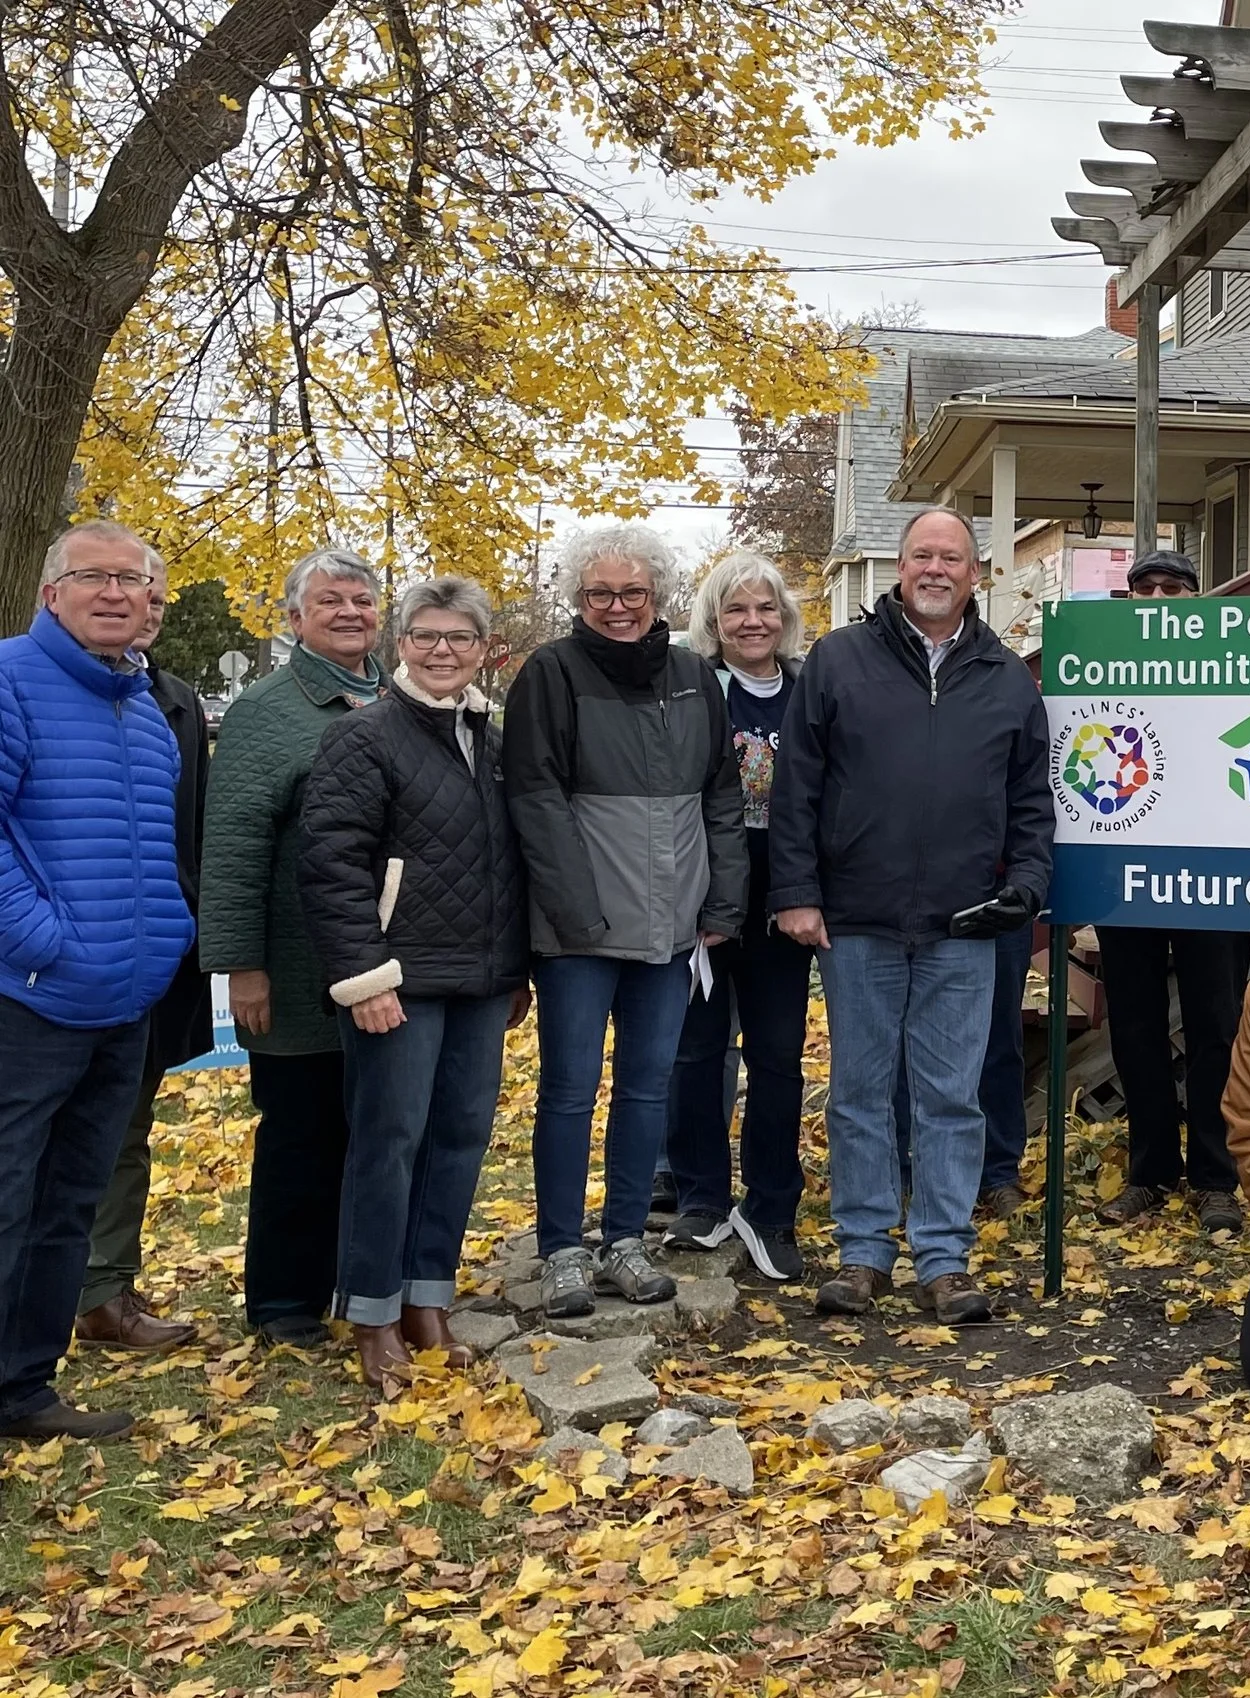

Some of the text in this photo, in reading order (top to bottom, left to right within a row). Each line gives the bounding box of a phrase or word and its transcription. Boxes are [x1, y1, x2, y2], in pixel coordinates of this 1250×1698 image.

[1134, 606, 1205, 640] The
[1080, 701, 1137, 719] LINCS
[1051, 722, 1166, 833] Lansing Intentional Communities
